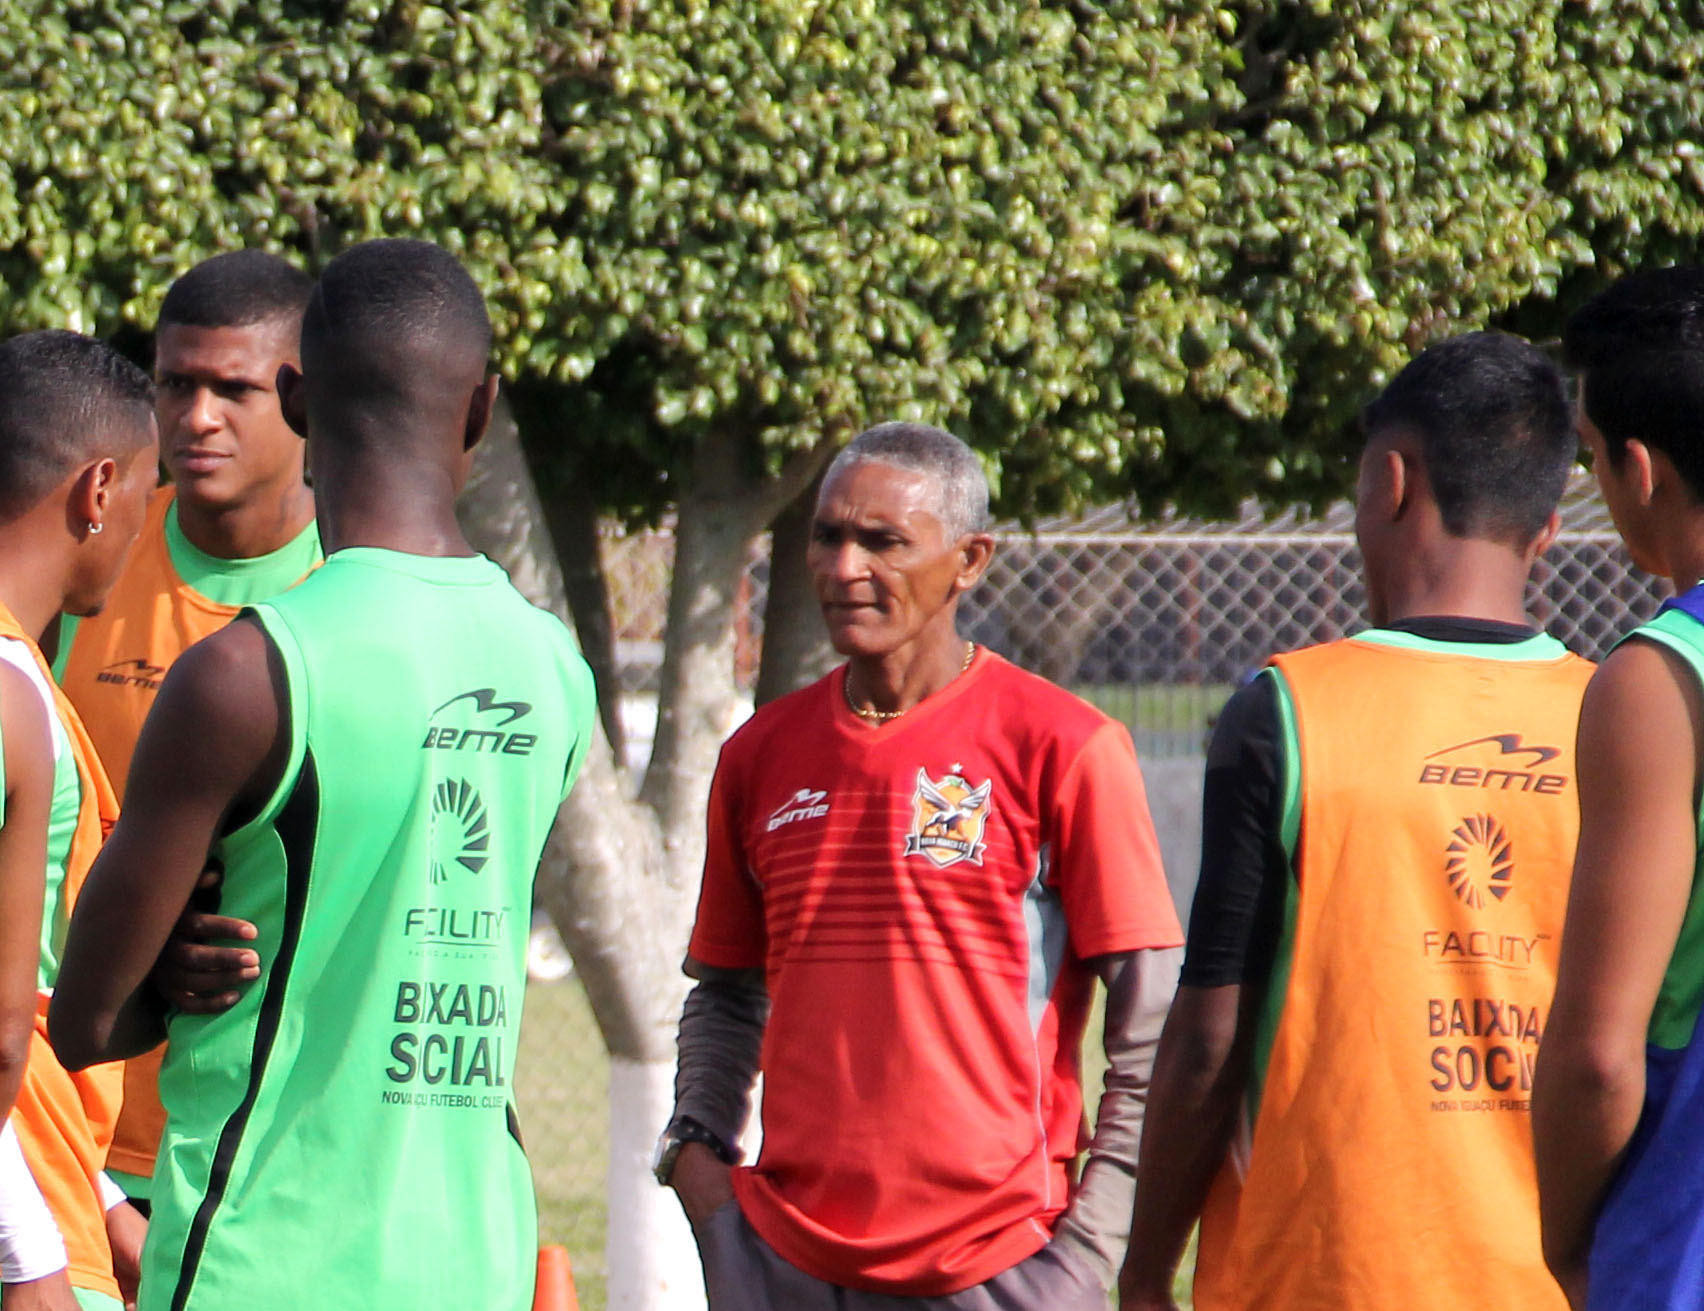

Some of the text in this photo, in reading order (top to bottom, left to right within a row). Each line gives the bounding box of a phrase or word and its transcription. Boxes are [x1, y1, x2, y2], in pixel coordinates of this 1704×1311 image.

[394, 971, 508, 1028] BXADA
[385, 1032, 506, 1087] SCIAL
[1430, 1045, 1536, 1093] SOCI
